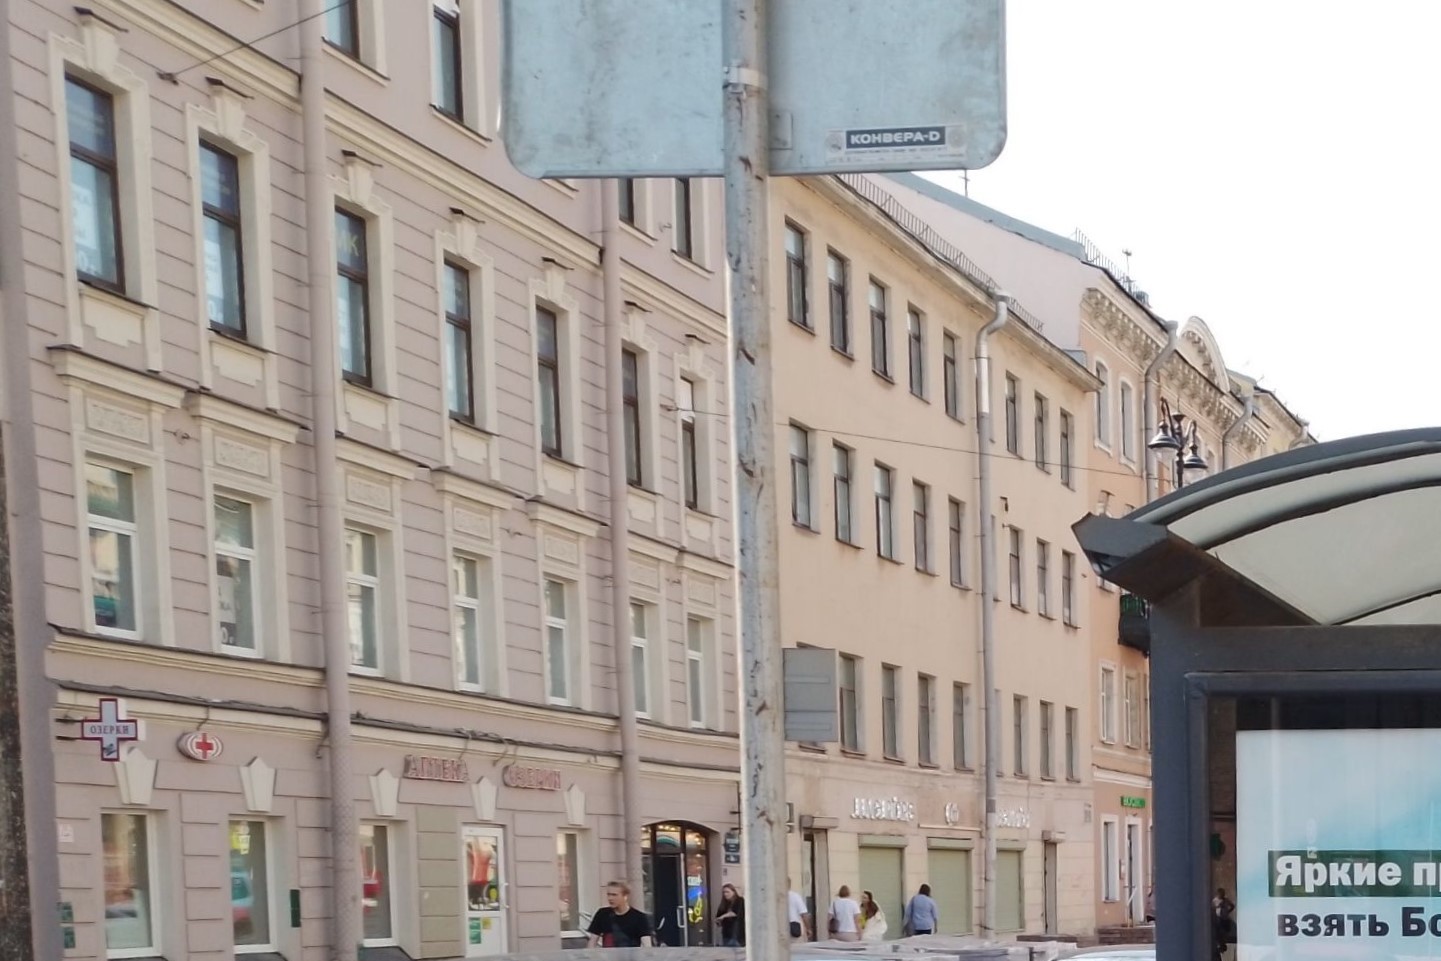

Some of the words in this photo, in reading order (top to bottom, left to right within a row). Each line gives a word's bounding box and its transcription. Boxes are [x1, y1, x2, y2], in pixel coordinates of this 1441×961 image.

[90, 723, 130, 735] ОЗЕРКИ
[1274, 855, 1402, 893] Яркие
[1277, 911, 1390, 938] взять
